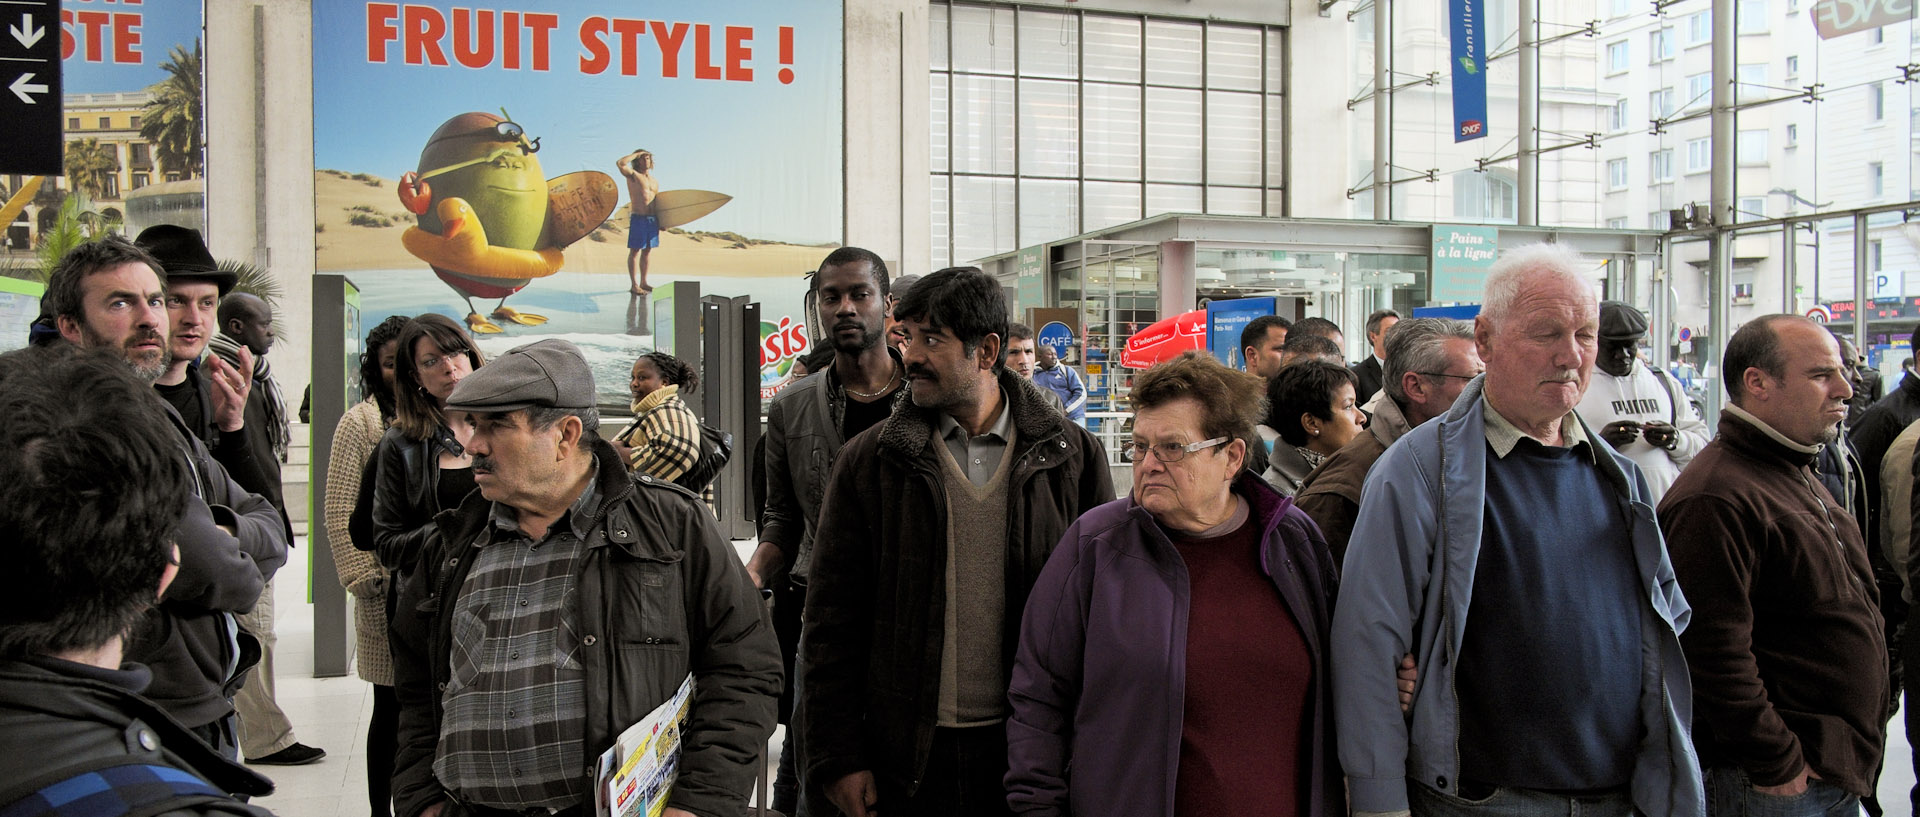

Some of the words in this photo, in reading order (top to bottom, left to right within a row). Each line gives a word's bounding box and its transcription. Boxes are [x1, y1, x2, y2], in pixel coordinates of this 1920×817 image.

[366, 2, 559, 72] FRUIT
[579, 15, 754, 82] STYLE
[777, 25, 795, 85] !
[1461, 123, 1481, 136] SNCF
[1449, 232, 1484, 244] Pains
[1437, 246, 1446, 258] à
[1449, 246, 1461, 258] la
[1877, 275, 1888, 294] P
[1041, 335, 1071, 347] CAFÉ
[1612, 399, 1660, 415] PUMA
